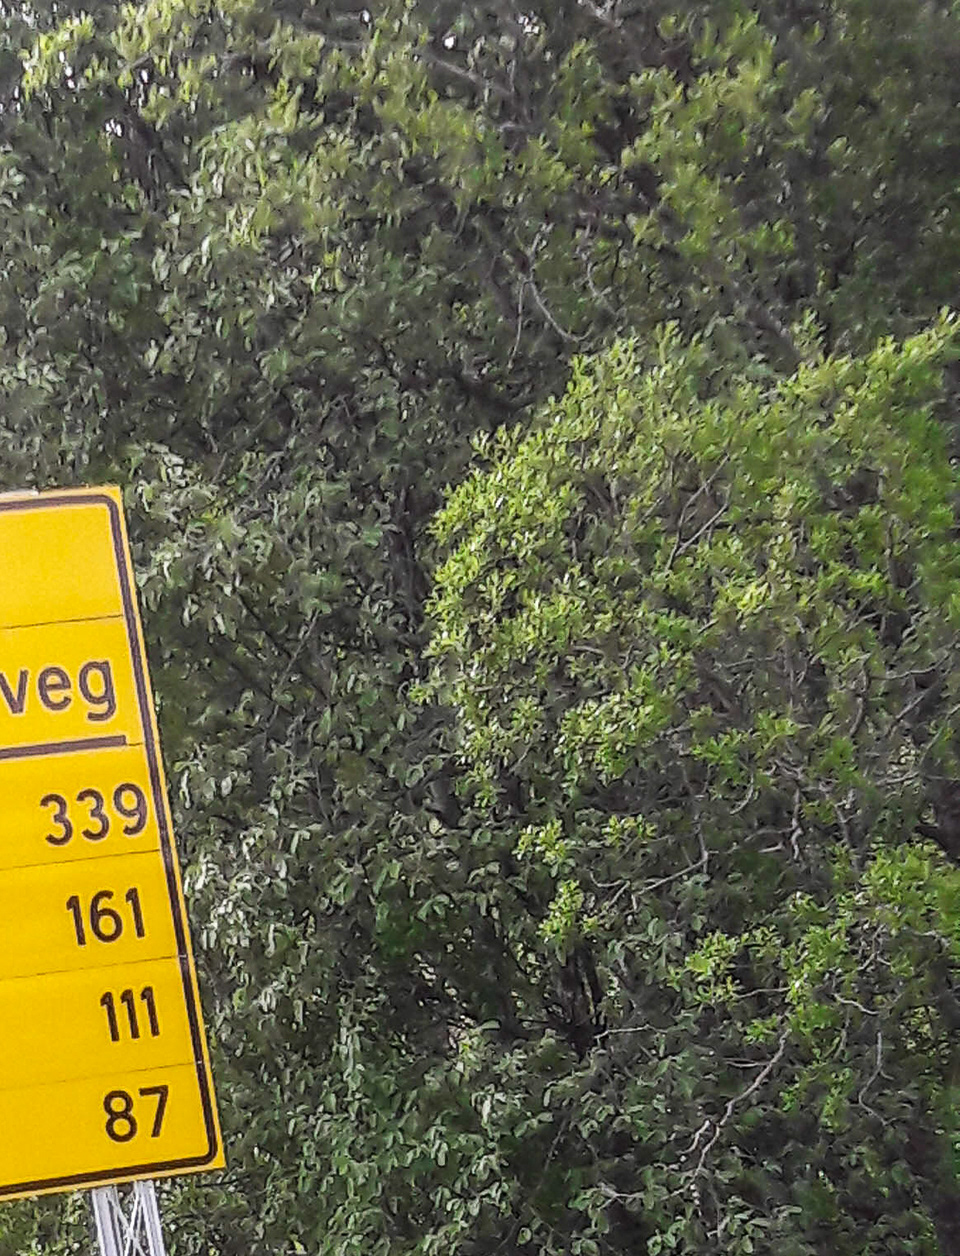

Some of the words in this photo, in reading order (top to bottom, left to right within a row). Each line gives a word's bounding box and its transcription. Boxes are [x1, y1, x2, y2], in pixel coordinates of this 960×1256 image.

[39, 782, 149, 848] 339
[65, 887, 147, 948] 161
[99, 985, 163, 1044] 111
[103, 1085, 171, 1143] 87
